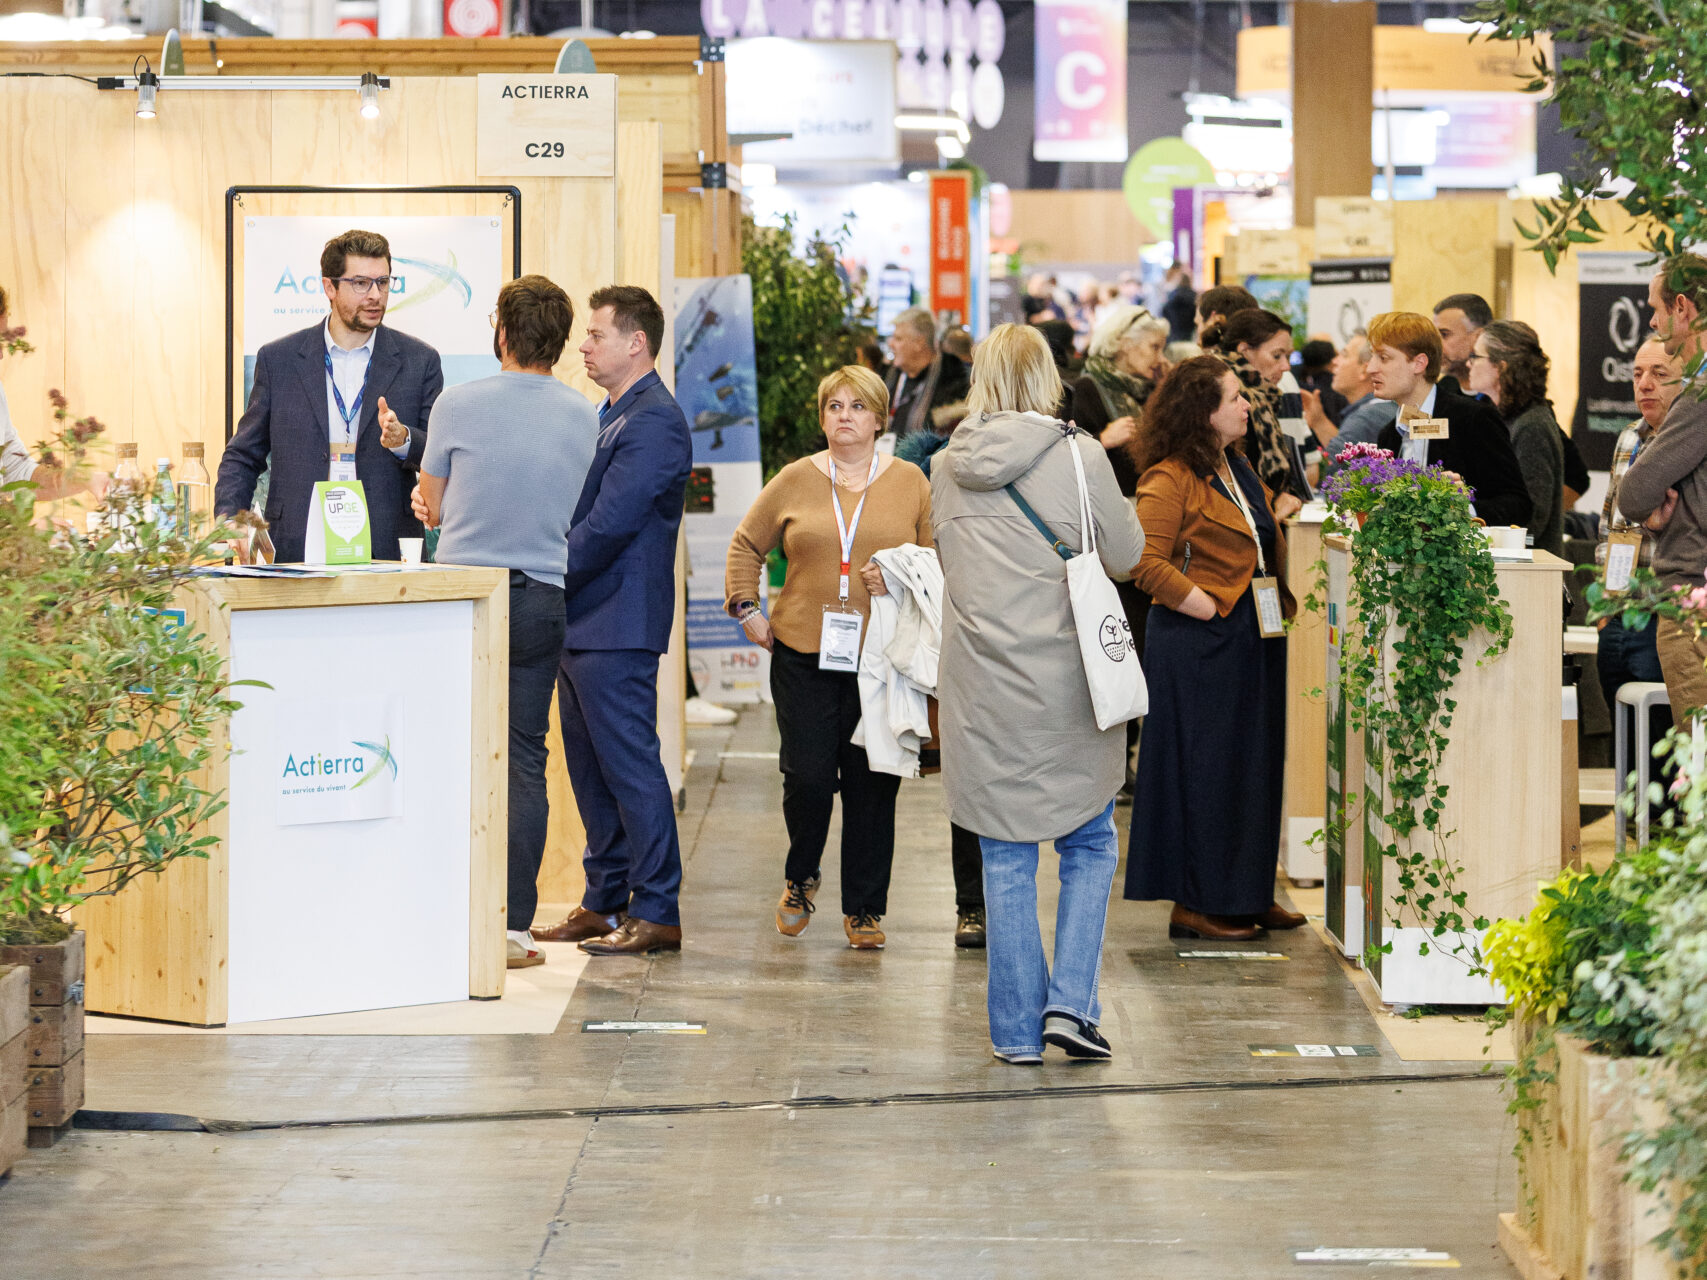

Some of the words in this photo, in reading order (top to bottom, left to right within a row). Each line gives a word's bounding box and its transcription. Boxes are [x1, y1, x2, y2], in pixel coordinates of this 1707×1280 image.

[1056, 51, 1106, 110] C
[502, 85, 589, 99] ACTIERRA
[525, 142, 565, 158] C29
[282, 752, 364, 778] Actierra
[292, 786, 315, 794] service
